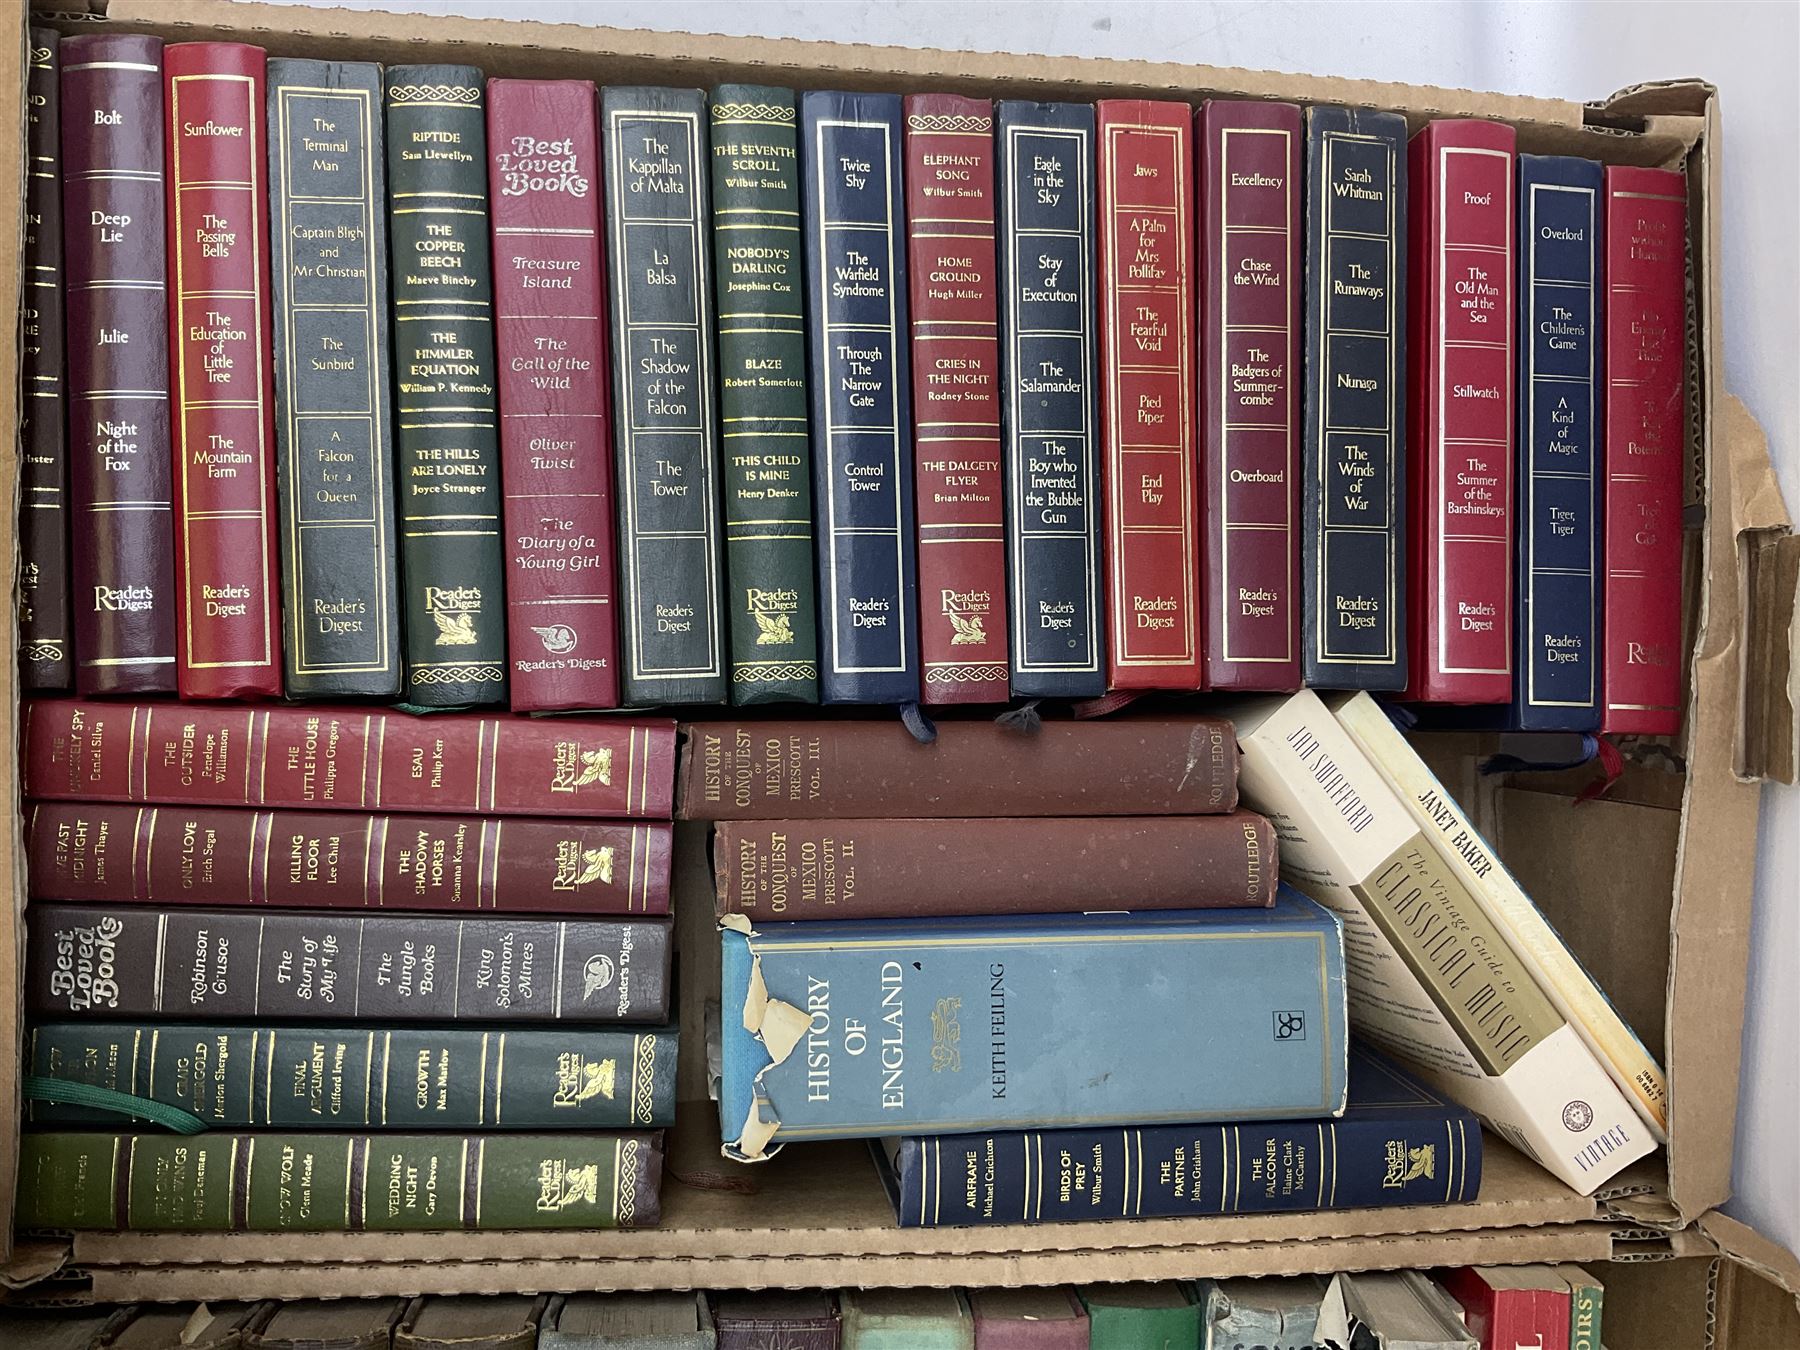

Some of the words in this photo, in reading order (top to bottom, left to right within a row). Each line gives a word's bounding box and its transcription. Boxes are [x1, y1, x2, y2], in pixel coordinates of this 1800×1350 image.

[95, 110, 122, 124] Bolt
[185, 121, 243, 136] Sunflower
[303, 138, 347, 152] Terminal
[413, 132, 460, 143] RIPTIDE
[512, 137, 573, 157] Best
[425, 150, 472, 162] Llewellyn
[496, 154, 578, 173] Loved
[924, 155, 980, 166] ELEPHANT
[629, 158, 681, 176] Kappillan
[733, 160, 779, 171] SCROLL
[840, 158, 870, 172] Twice
[1035, 157, 1063, 176] Eagle
[1134, 164, 1157, 177] Jaws
[936, 170, 969, 180] SONG
[1232, 173, 1282, 189] Excellency
[1345, 168, 1371, 182] Sarah
[502, 173, 588, 197] Books
[648, 178, 683, 193] Malta
[923, 188, 954, 196] Wilbur
[958, 188, 982, 197] Smith
[1333, 183, 1382, 200] Whitman
[1038, 189, 1059, 206] Sky
[1465, 192, 1491, 204] Proof
[92, 211, 131, 227] Deep
[1143, 219, 1165, 232] Palm
[101, 229, 123, 242] Lie
[197, 230, 235, 245] Passing
[293, 226, 334, 240] Captain
[338, 226, 363, 241] Bligh
[426, 225, 451, 235] THE
[1542, 227, 1582, 240] Overlord
[416, 241, 465, 252] COPPER
[728, 248, 789, 259] NOBODY'S
[655, 250, 668, 264] La
[938, 257, 971, 267] HOME
[1136, 249, 1158, 262] Mrs
[316, 265, 364, 277] Christian
[513, 257, 580, 270] Treasure
[733, 263, 786, 273] DARLING
[1039, 255, 1062, 272] Stay
[1241, 259, 1271, 271] Chase
[647, 269, 676, 284] Balsa
[835, 267, 878, 280] Warfield
[930, 272, 980, 282] GROUND
[1468, 267, 1487, 280] The
[523, 276, 571, 288] Island
[1335, 280, 1383, 299] Runaways
[1456, 281, 1474, 293] Old
[833, 282, 883, 298] Syndrome
[1023, 288, 1076, 302] Execution
[191, 327, 246, 340] Education
[1541, 322, 1584, 335] Children's
[98, 329, 128, 345] Julie
[1136, 338, 1161, 351] Void
[416, 349, 473, 359] HIMMLER
[837, 346, 881, 362] Through
[312, 358, 354, 370] Sunbird
[411, 364, 479, 377] EQUATION
[642, 358, 689, 373] Shadow
[746, 359, 781, 369] BLAZE
[1232, 364, 1269, 379] Badgers
[842, 378, 881, 390] Narrow
[1020, 379, 1081, 394] Salamander
[1338, 374, 1376, 391] Nunaga
[1454, 385, 1499, 398] Stillwatch
[1140, 395, 1161, 408] Pied
[97, 421, 137, 438] Night
[98, 439, 111, 453] of
[114, 439, 137, 453] the
[209, 435, 233, 449] The
[194, 451, 252, 464] Mountain
[319, 450, 353, 461] Falcon
[445, 449, 479, 459] HILLS
[764, 456, 800, 465] CHILD
[106, 457, 130, 470] Fox
[437, 465, 486, 475] LONELY
[531, 457, 574, 469] Twist
[845, 463, 883, 475] Control
[1030, 458, 1051, 475] Boy
[1339, 462, 1374, 476] Winds
[946, 476, 977, 485] FLYER
[1032, 474, 1076, 488] Invented
[1142, 474, 1162, 487] End
[1231, 470, 1283, 482] Overboard
[1457, 473, 1497, 485] Summer
[848, 479, 880, 491] Tower
[1042, 510, 1066, 523] Gun
[1448, 502, 1504, 517] Barshinskeys
[1550, 508, 1575, 521] Tiger,
[94, 585, 153, 611] Reader's
[118, 600, 152, 611] Digest
[941, 590, 990, 611] Reader's
[1134, 596, 1177, 610] Reader's
[657, 604, 693, 616] Reader's
[658, 619, 690, 634] Digest
[1138, 614, 1174, 630] Digest
[516, 660, 565, 672] Reader's
[567, 658, 607, 670] Digest
[326, 720, 339, 758] Gregory
[433, 740, 443, 758] Kerr
[412, 749, 423, 777] ESAU
[705, 735, 720, 800] HISTORY
[736, 729, 752, 806] CONQUEST
[766, 739, 780, 795] MEXICO
[790, 736, 800, 800] PRESCOTT
[324, 761, 336, 799] Philippa
[432, 761, 443, 787] Philip
[1287, 726, 1319, 760] JAN
[1309, 754, 1373, 833] SWAFFORD
[1418, 790, 1458, 832] JANET
[1452, 831, 1491, 878] BAKER
[291, 836, 303, 882] KILLING
[308, 839, 320, 880] FLOOR
[432, 840, 445, 885] HORSES
[1243, 823, 1259, 901] ROUTLEDGE
[741, 839, 756, 906] HISTORY
[772, 832, 788, 911] CONQUEST
[802, 842, 816, 899] MEXICO
[823, 839, 835, 904] PRESCOTT
[1407, 849, 1428, 875] The
[1430, 879, 1469, 931] Vintage
[1471, 936, 1503, 975] Guide
[1502, 982, 1515, 992] to
[191, 930, 208, 1003] Robinson
[399, 941, 416, 996] Jungle
[477, 949, 494, 988] King
[1375, 862, 1475, 989] CLASSICAL
[1465, 982, 1529, 1061] MUSIC
[420, 945, 435, 995] Books
[496, 933, 513, 1008] Solomon's
[519, 943, 533, 998] Mines
[990, 963, 1005, 1039] FEILING
[808, 976, 829, 1102] HISTORY
[845, 1018, 866, 1055] OF
[882, 962, 903, 1108] ENGLAND
[992, 1042, 1006, 1098] KEITH
[1192, 1141, 1201, 1170] Grisham
[1575, 1125, 1630, 1171] VINTAGE
[985, 1139, 993, 1181] Crichton
[1061, 1151, 1070, 1167] OF
[1161, 1162, 1170, 1184] THE
[1175, 1147, 1184, 1196] PARTNER
[1267, 1139, 1276, 1197] FALCONER
[967, 1152, 976, 1207] AIRFRAME
[1076, 1163, 1085, 1189] PREY
[406, 1166, 417, 1207] NIGHT
[1061, 1170, 1070, 1201] BIRDS
[1191, 1177, 1200, 1201] John
[984, 1183, 993, 1216] Michael
